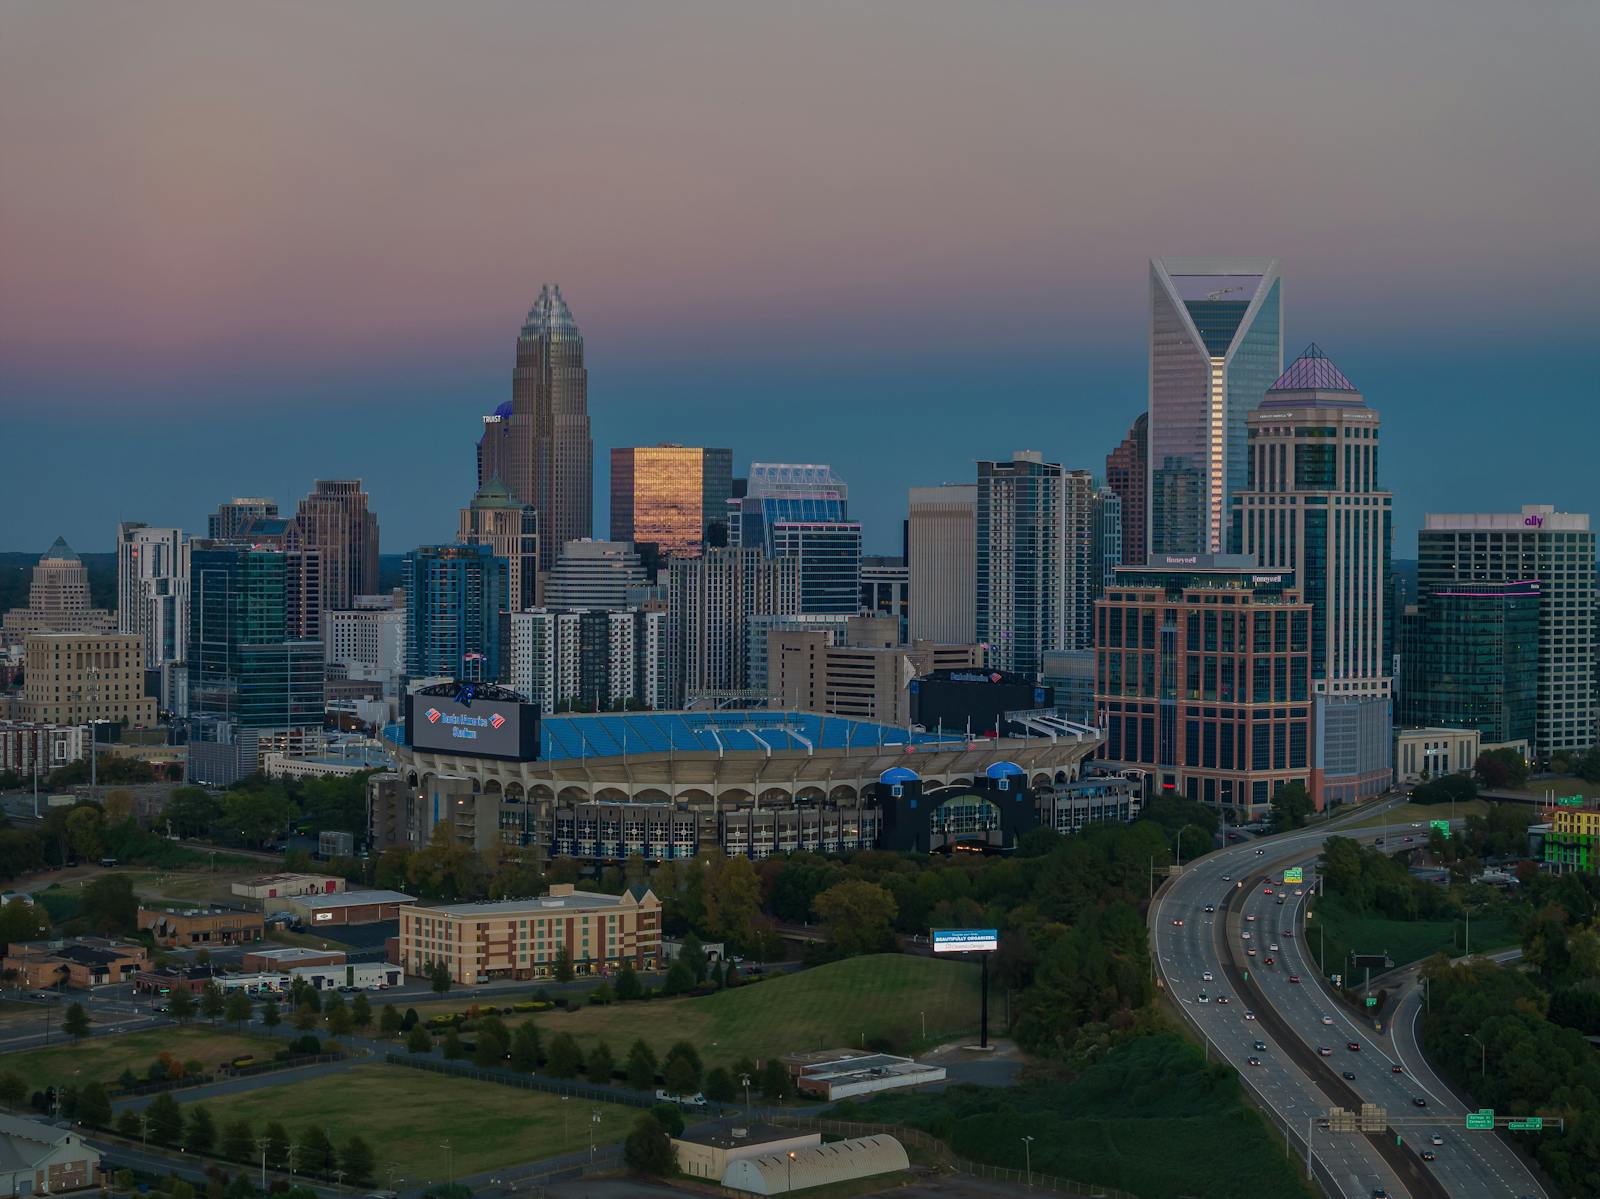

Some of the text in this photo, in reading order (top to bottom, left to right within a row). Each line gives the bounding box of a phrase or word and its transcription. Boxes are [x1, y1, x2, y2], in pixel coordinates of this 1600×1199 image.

[1524, 515, 1544, 528] ally
[1166, 556, 1197, 564] Honeywell
[1252, 575, 1281, 583] Honeywell
